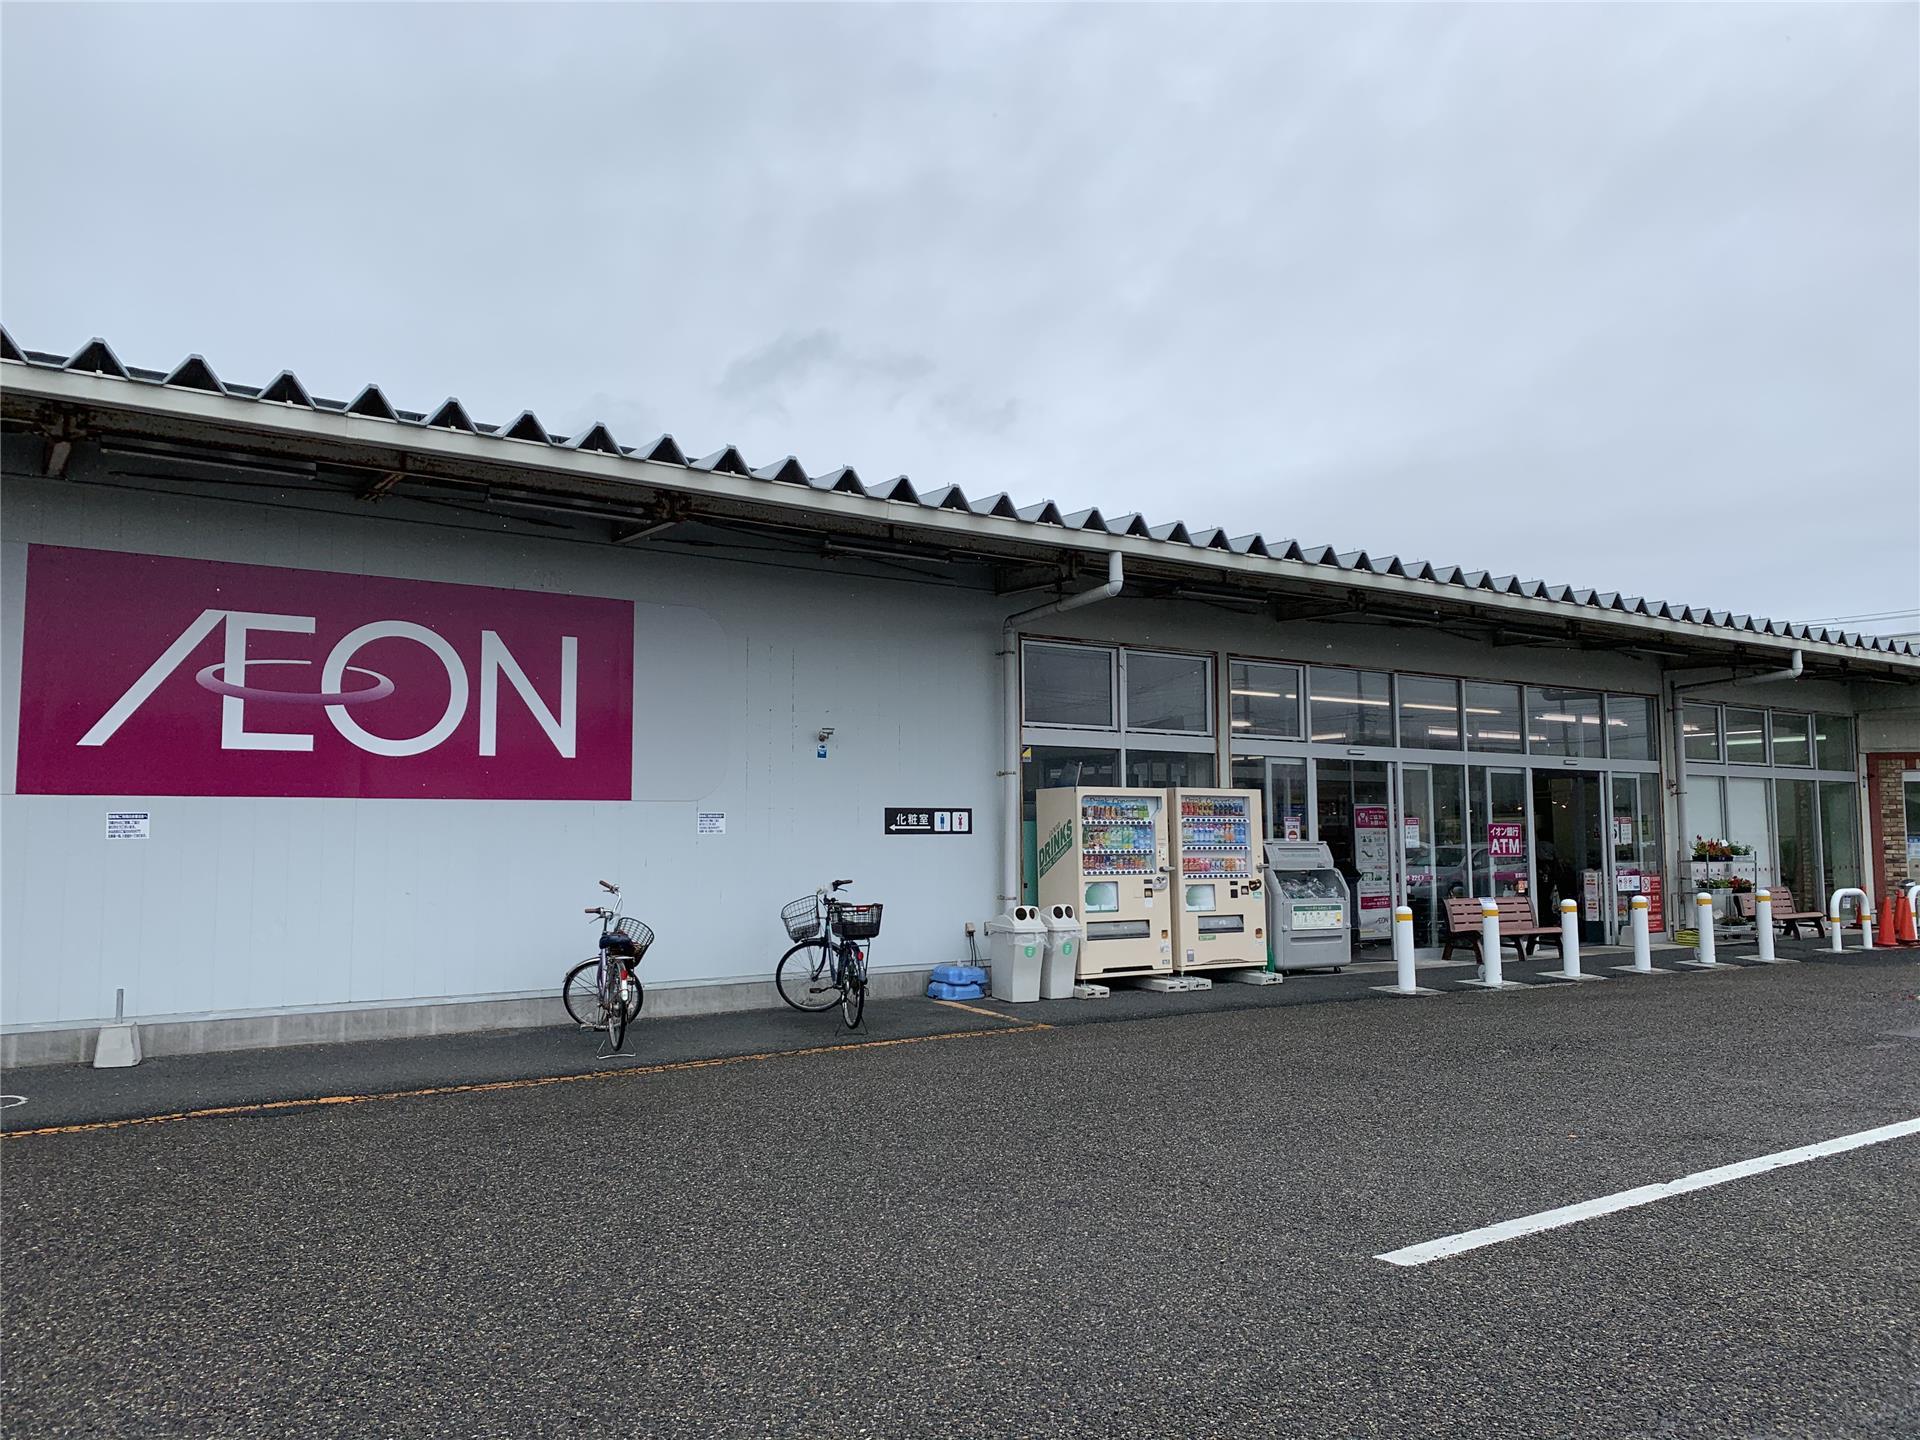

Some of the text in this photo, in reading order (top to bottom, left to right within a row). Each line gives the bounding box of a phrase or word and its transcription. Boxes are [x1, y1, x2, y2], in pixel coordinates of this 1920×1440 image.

[896, 813, 929, 825] 化粧室
[1490, 826, 1520, 837] イオン銀行
[1038, 819, 1073, 869] DRINKS
[1491, 839, 1520, 853] ATM
